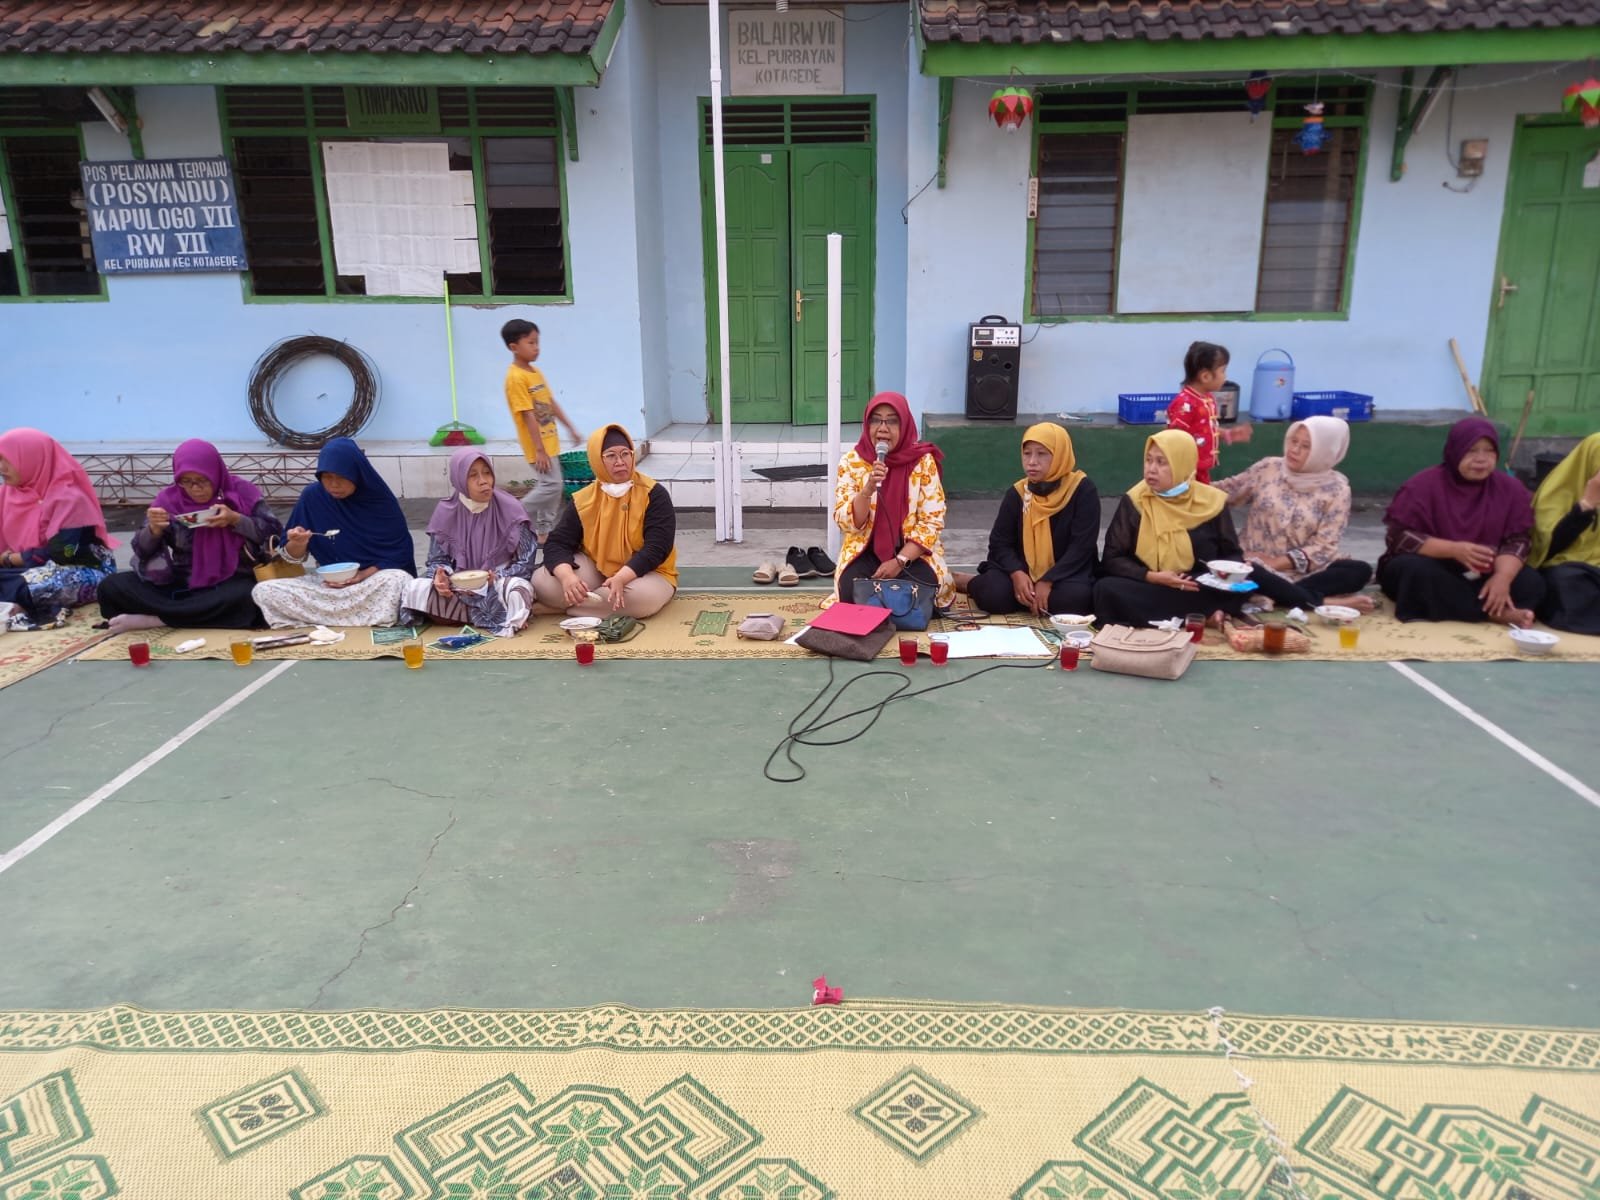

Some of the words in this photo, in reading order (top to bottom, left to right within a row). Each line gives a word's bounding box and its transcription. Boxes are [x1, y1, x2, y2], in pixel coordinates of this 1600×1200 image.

[737, 21, 787, 46] BALAI
[789, 21, 814, 46] RW
[817, 20, 836, 46] VII
[767, 48, 836, 65] PURBAYAN
[755, 68, 823, 84] KOTAGEDE
[83, 165, 108, 182] POS
[110, 162, 175, 181] PELAYANAN
[177, 160, 228, 179] TERPADU
[93, 207, 197, 232] KAPULOGO
[201, 205, 236, 229] VII
[127, 233, 165, 256] RW
[174, 231, 210, 255] VII
[125, 257, 171, 269] PURBAYAN
[193, 255, 239, 267] KOTAGEDE
[0, 1022, 98, 1038] WAN
[551, 1018, 677, 1038] SWAN
